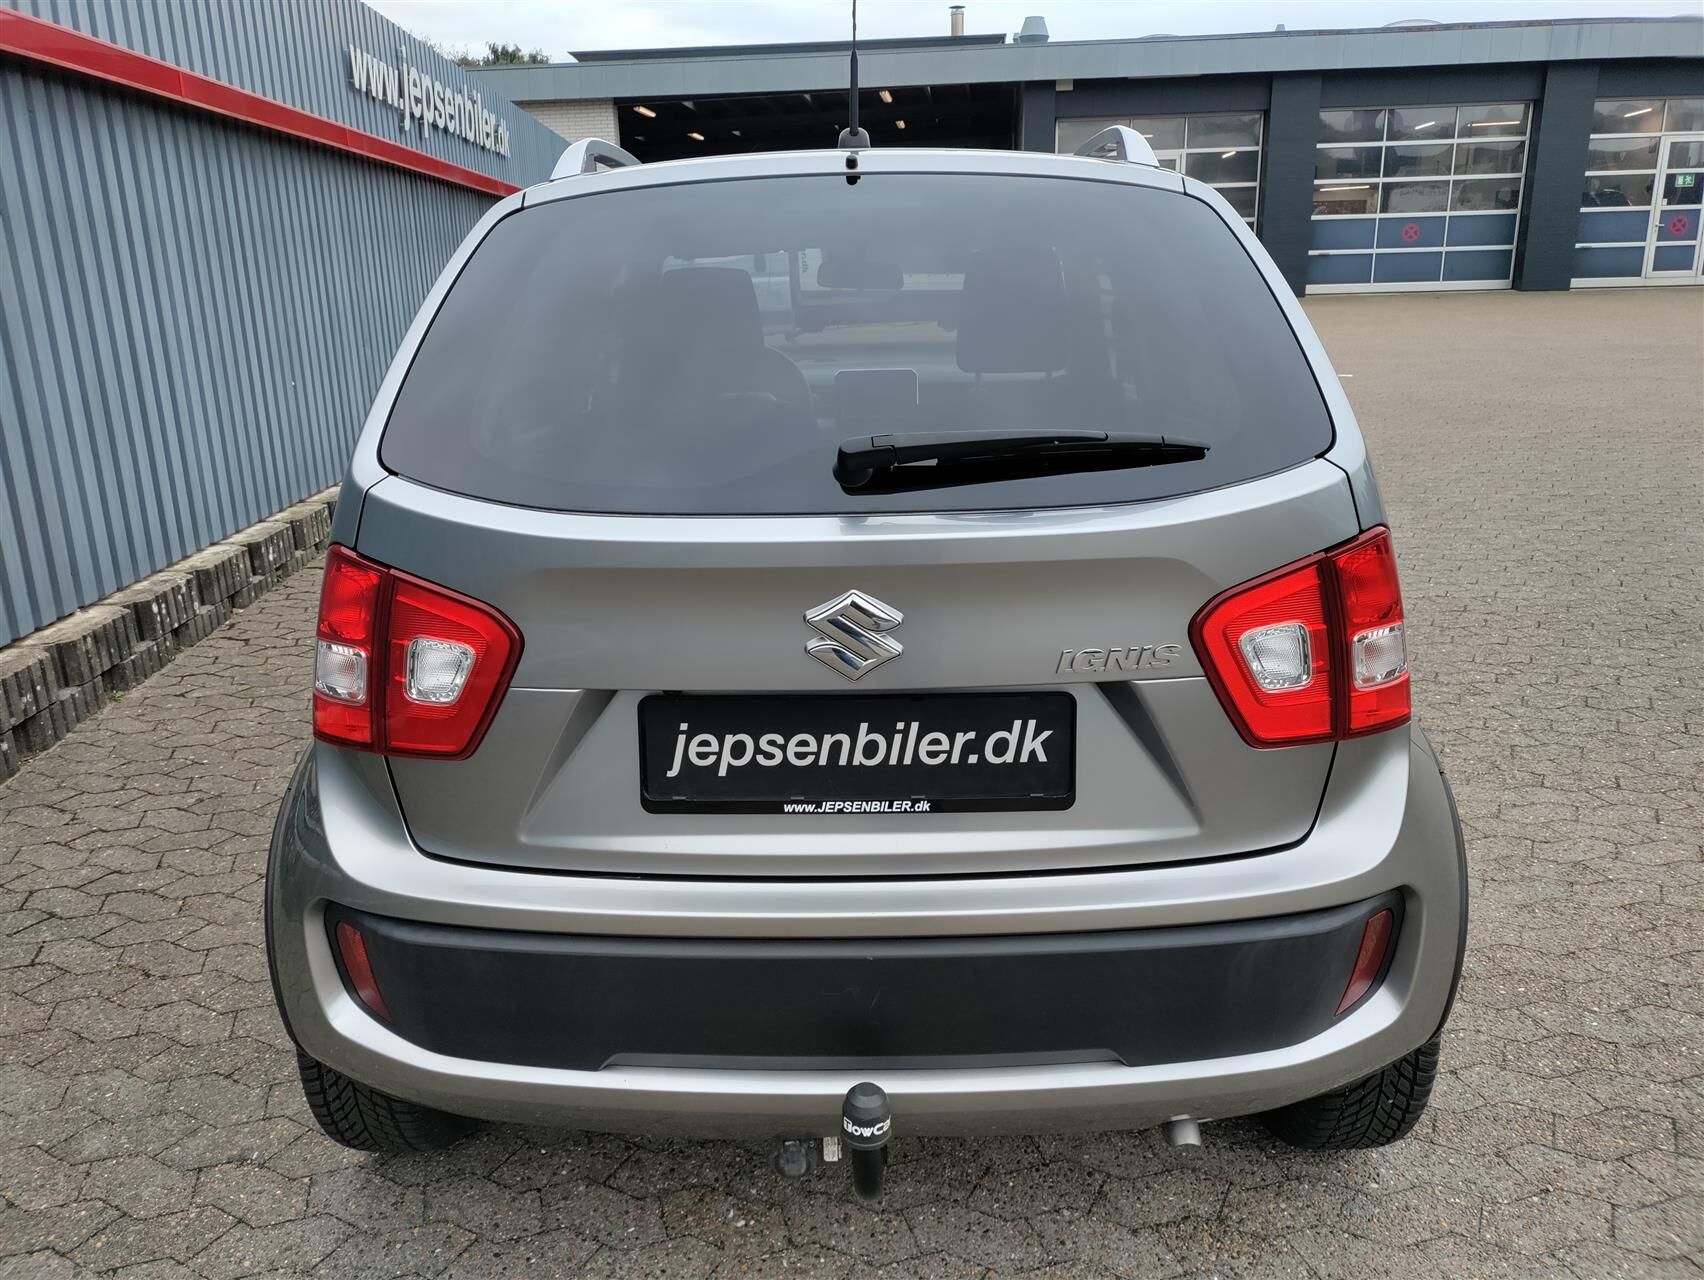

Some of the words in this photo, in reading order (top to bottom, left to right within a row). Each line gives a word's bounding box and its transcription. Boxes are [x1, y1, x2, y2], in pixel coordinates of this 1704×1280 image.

[350, 45, 510, 157] www.jepsenbiler.dk
[1056, 643, 1183, 673] IGNIS
[666, 719, 1054, 777] jepsenbiler.dk
[783, 800, 931, 813] www.JEPSENBILER.dk
